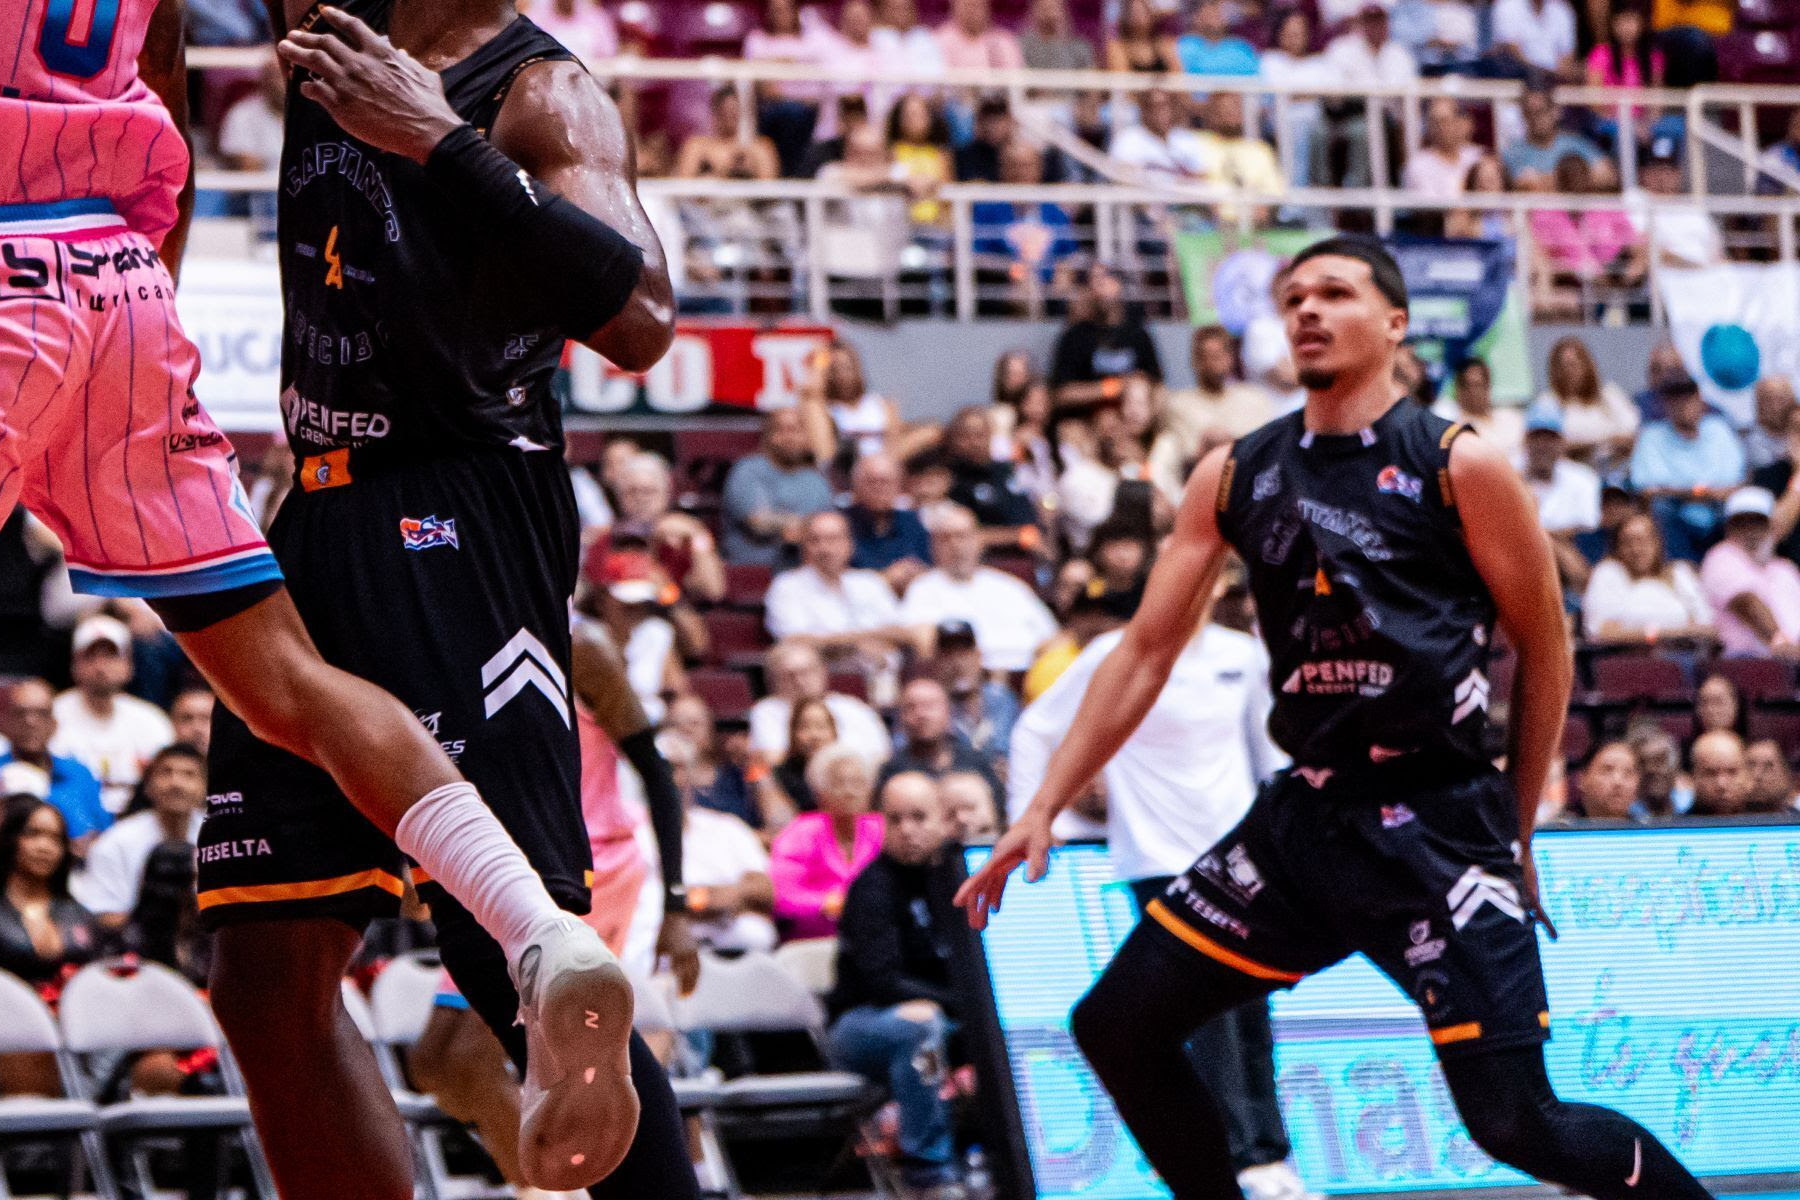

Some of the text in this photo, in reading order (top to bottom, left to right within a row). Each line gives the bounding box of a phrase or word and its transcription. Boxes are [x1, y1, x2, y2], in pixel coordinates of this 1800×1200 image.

[300, 397, 390, 438] PENFED
[1301, 660, 1394, 686] PENFED
[201, 839, 272, 864] TESELTA
